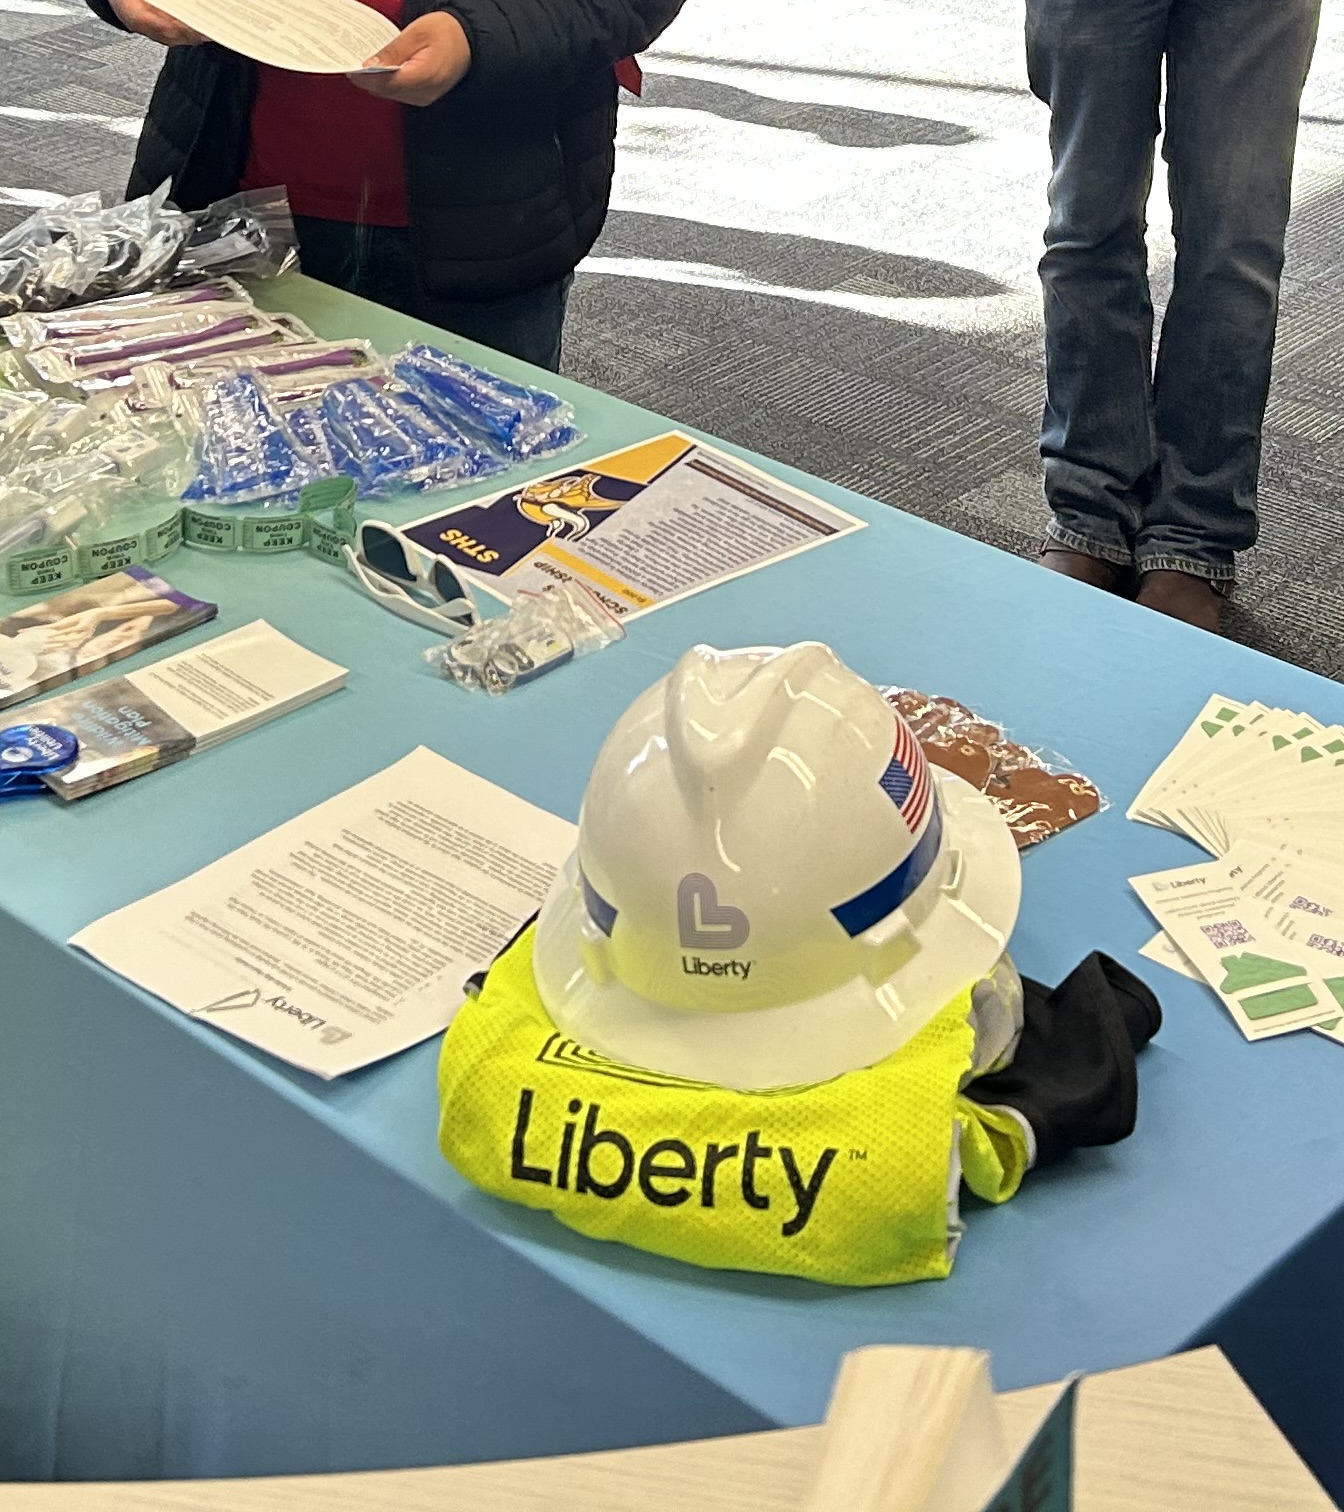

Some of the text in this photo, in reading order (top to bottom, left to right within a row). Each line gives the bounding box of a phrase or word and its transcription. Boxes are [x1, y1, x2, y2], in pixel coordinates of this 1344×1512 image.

[255, 521, 301, 533] COUPON
[91, 540, 138, 557] COUPON
[263, 536, 293, 546] KEEP
[439, 528, 500, 563] STHS
[20, 554, 68, 572] COUPON
[101, 556, 131, 570] KEEP
[30, 571, 62, 585] KEEP
[82, 699, 152, 746] Mitigation
[1170, 876, 1206, 888] Liberty
[682, 956, 752, 980] Liberty
[265, 995, 326, 1030] Liberty
[511, 1088, 839, 1238] Liberty
